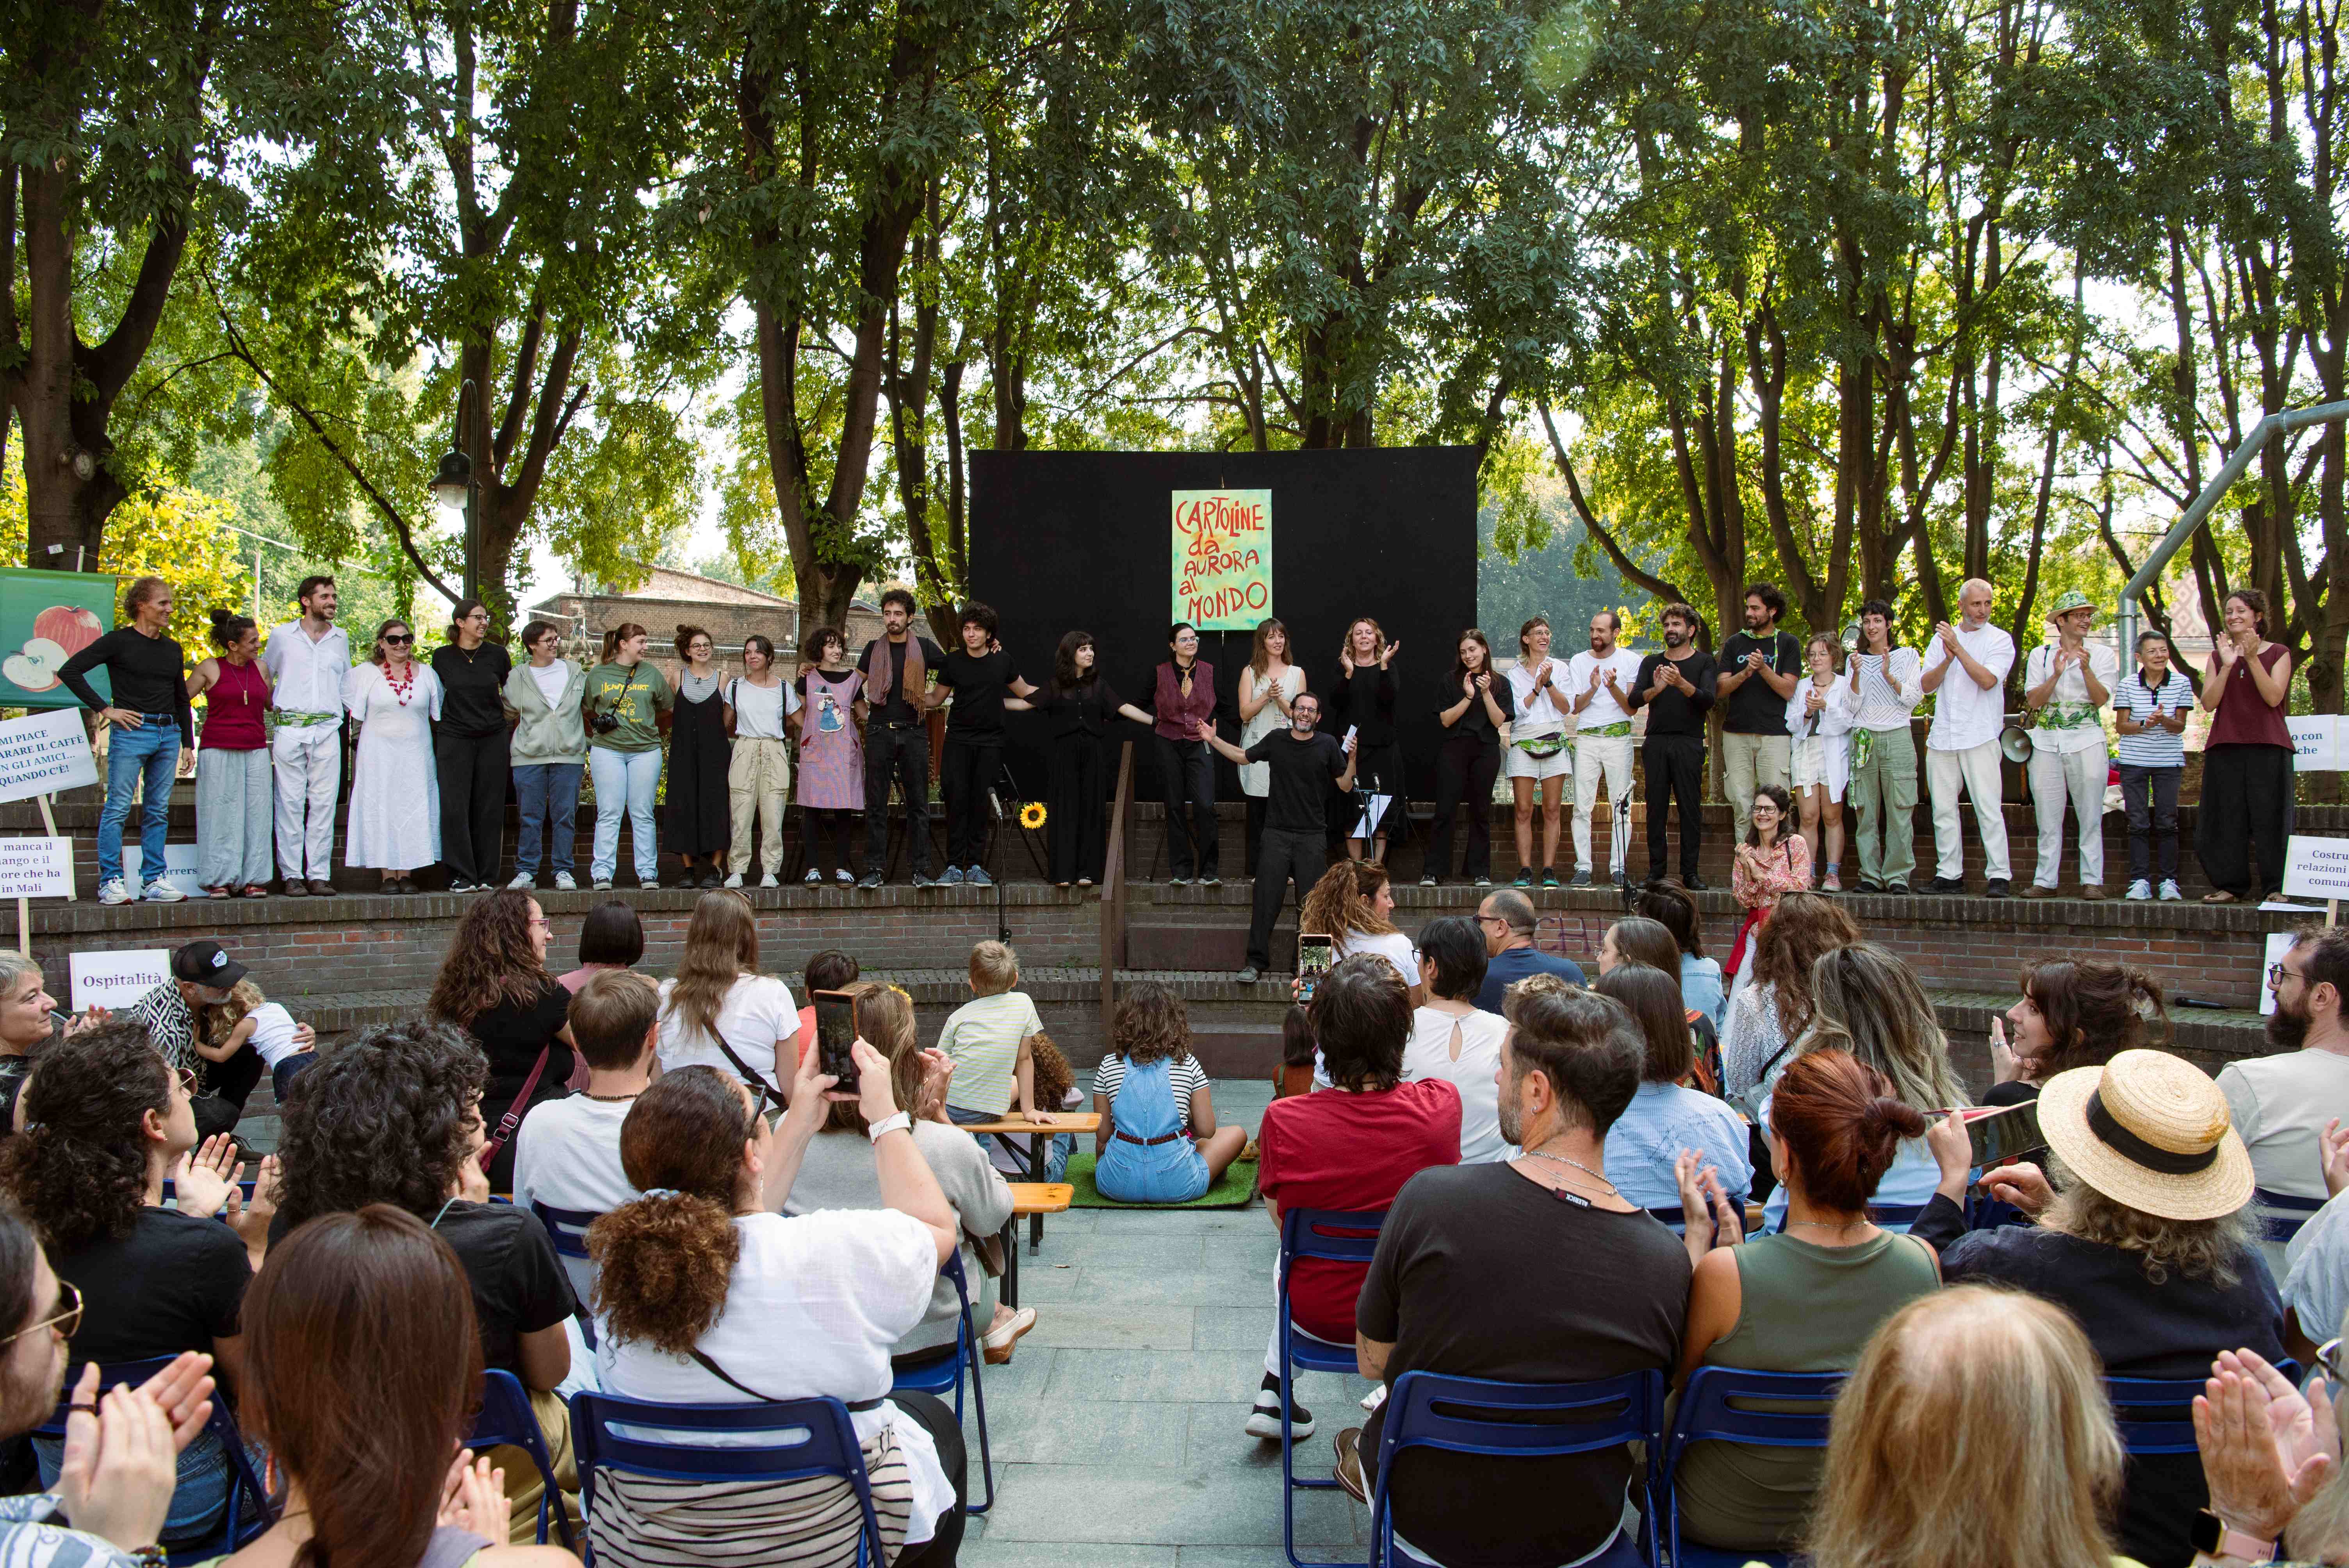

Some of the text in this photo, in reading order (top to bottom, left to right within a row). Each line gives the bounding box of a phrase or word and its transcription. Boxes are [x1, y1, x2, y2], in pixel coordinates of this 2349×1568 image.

[1188, 533, 1220, 556] da
[1184, 549, 1259, 577] AURORA
[1179, 575, 1197, 595] al
[1188, 582, 1267, 627] MONDO
[626, 684, 650, 692] SHIRT
[15, 730, 48, 742] PIACE
[36, 743, 48, 752] IL
[50, 734, 84, 748] CAFFÈ
[12, 759, 32, 769] GLI
[34, 752, 75, 765] AMICI...
[0, 769, 46, 787] QUANDO
[0, 858, 29, 867] ango
[42, 855, 50, 864] il
[2296, 863, 2346, 873] relazioni
[24, 870, 43, 878] che
[46, 869, 61, 877] ha
[2, 883, 42, 893] in Mali
[83, 973, 162, 990] Ospitalità
